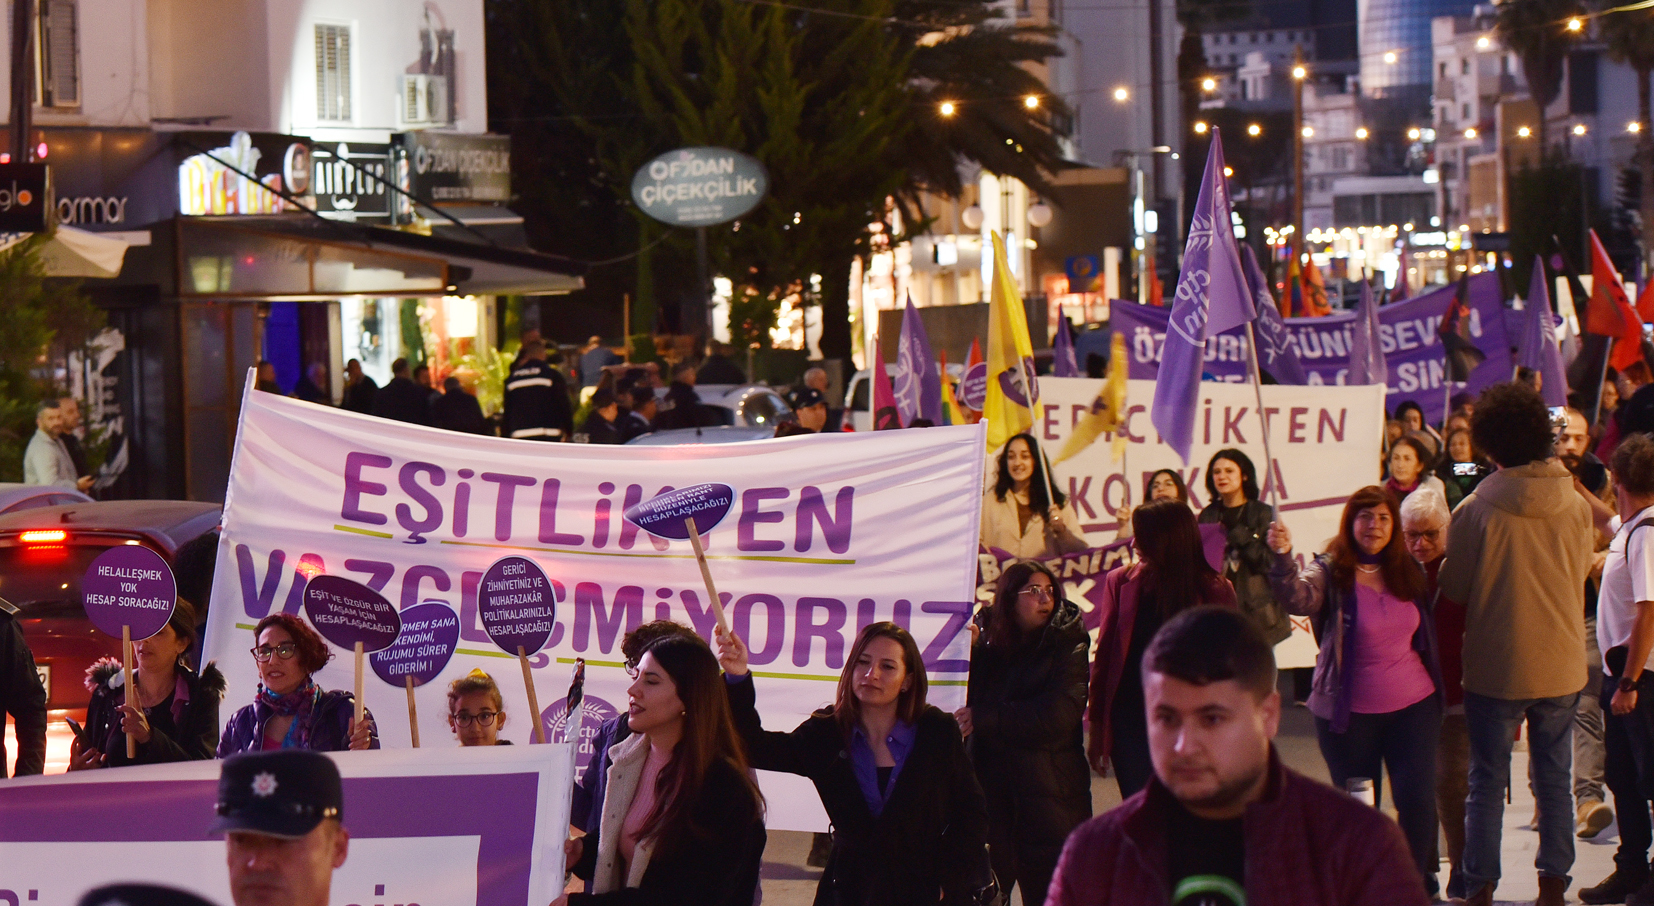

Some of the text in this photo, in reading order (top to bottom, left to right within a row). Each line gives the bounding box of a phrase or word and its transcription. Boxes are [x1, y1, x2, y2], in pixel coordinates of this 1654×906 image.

[98, 566, 162, 581] HELALLEŞMEK
[502, 562, 526, 576] GERİCİ
[120, 582, 137, 593] YOK
[487, 577, 543, 592] ZİHNİYETİNİZ VE
[86, 593, 169, 610] HESAP SORACAĞIZ!
[310, 589, 390, 612] EŞİT VE ÖZGÜR BİR
[489, 591, 543, 606] MUHAFAZAKÂR
[328, 603, 357, 616] YAŞAM
[484, 606, 553, 622] POLİTİKALARINIZLA
[315, 614, 395, 633] HESAPLAŞACAĞIZ!
[431, 617, 456, 629] SANA
[488, 620, 551, 636] HESAPLAŞACAĞIZ!
[377, 643, 448, 662] RUJUMU SÜRER
[389, 660, 427, 675] GİDERİM
